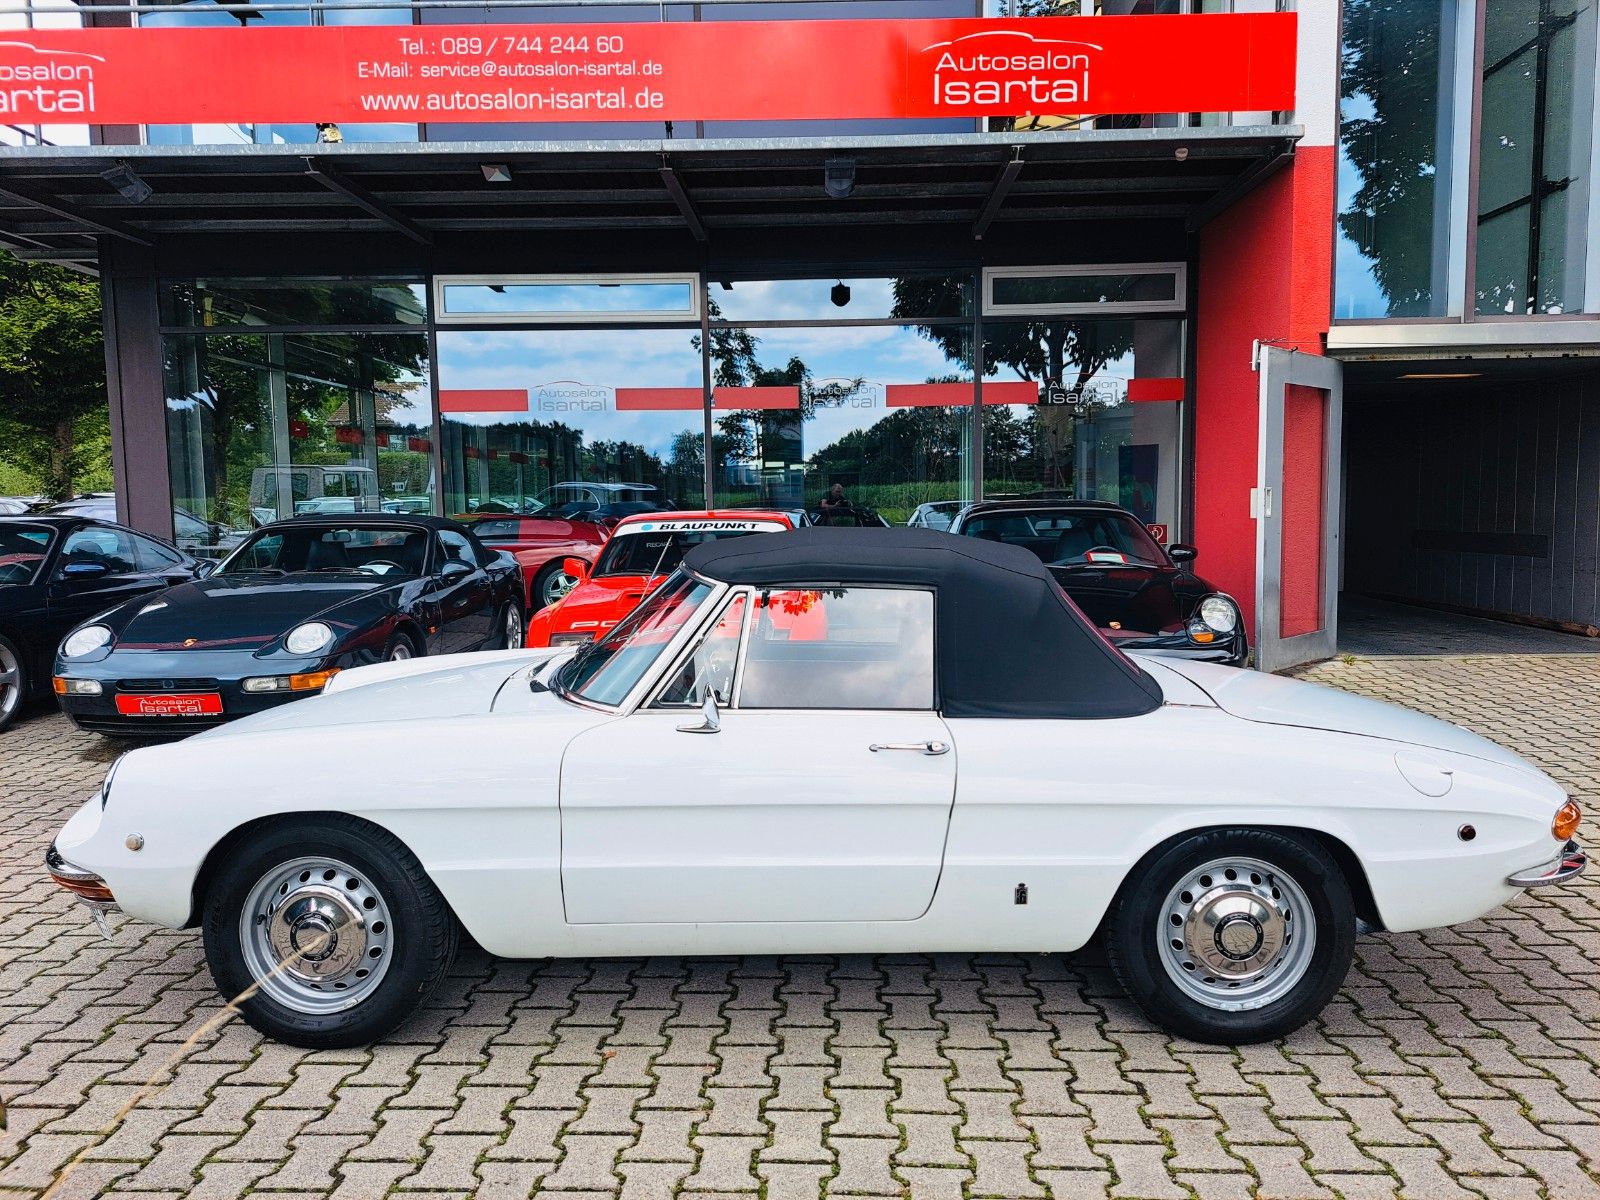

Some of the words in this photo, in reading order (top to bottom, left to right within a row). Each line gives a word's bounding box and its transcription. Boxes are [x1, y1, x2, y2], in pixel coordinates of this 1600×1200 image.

[398, 37, 436, 56] Tel.:
[441, 36, 482, 56] 089
[503, 36, 543, 54] 744
[550, 35, 590, 54] 244
[596, 35, 624, 54] 60
[357, 61, 414, 79] E-Mail:
[420, 59, 663, 78] service@autosalon-isartal.de
[935, 50, 1090, 72] Autosalon
[933, 70, 1090, 105] Isartal
[360, 86, 665, 111] www.autosalon-isartal.de
[539, 388, 606, 398] Autosalon
[538, 397, 608, 412] Isartal
